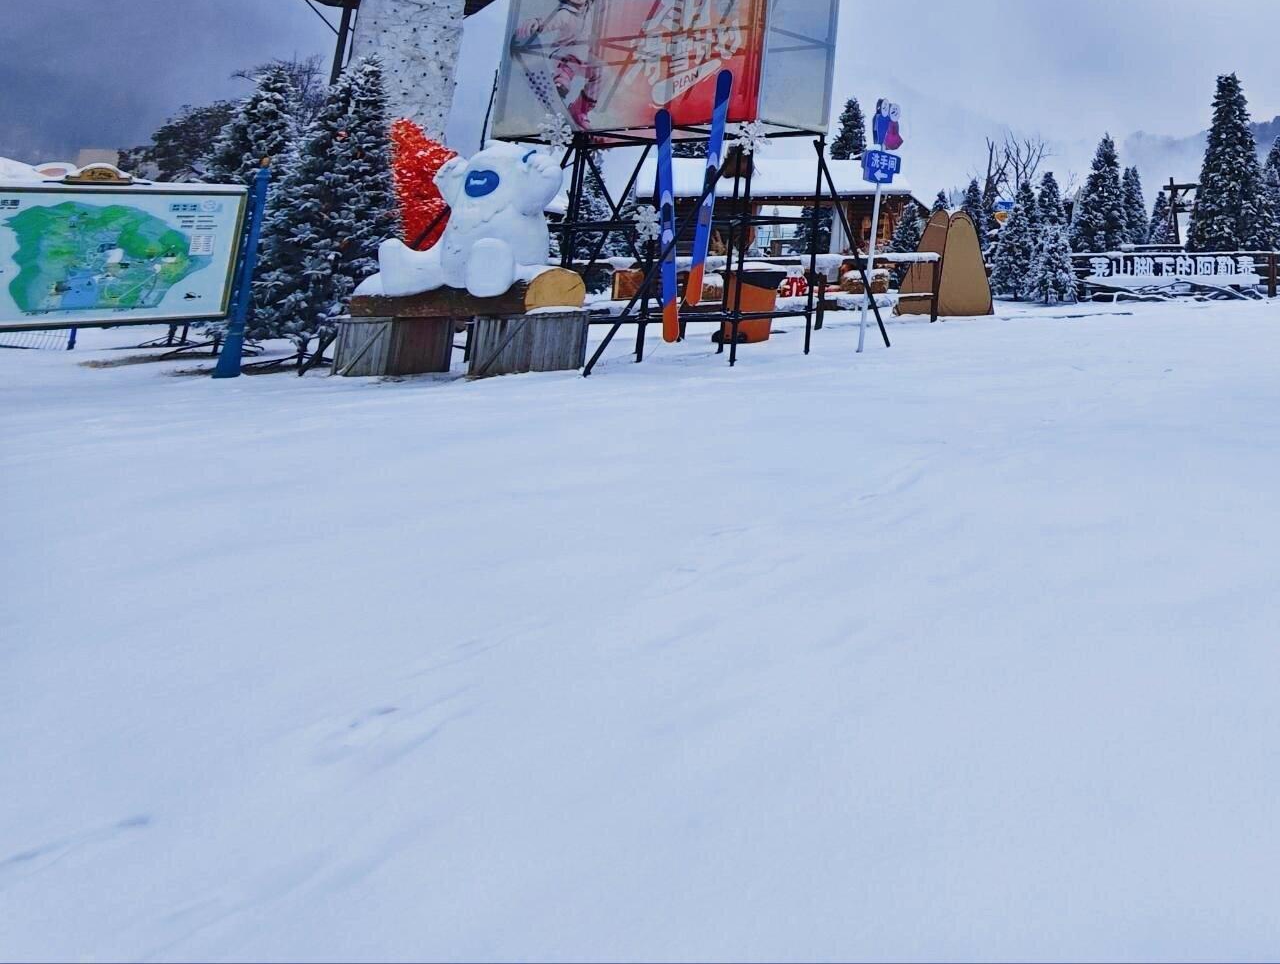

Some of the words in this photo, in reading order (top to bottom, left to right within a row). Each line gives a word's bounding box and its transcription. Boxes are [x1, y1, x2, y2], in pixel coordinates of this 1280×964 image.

[672, 70, 699, 94] PLAN
[870, 153, 897, 171] 洗手间
[1089, 255, 1256, 278] 茅山脚下的阿勒泰
